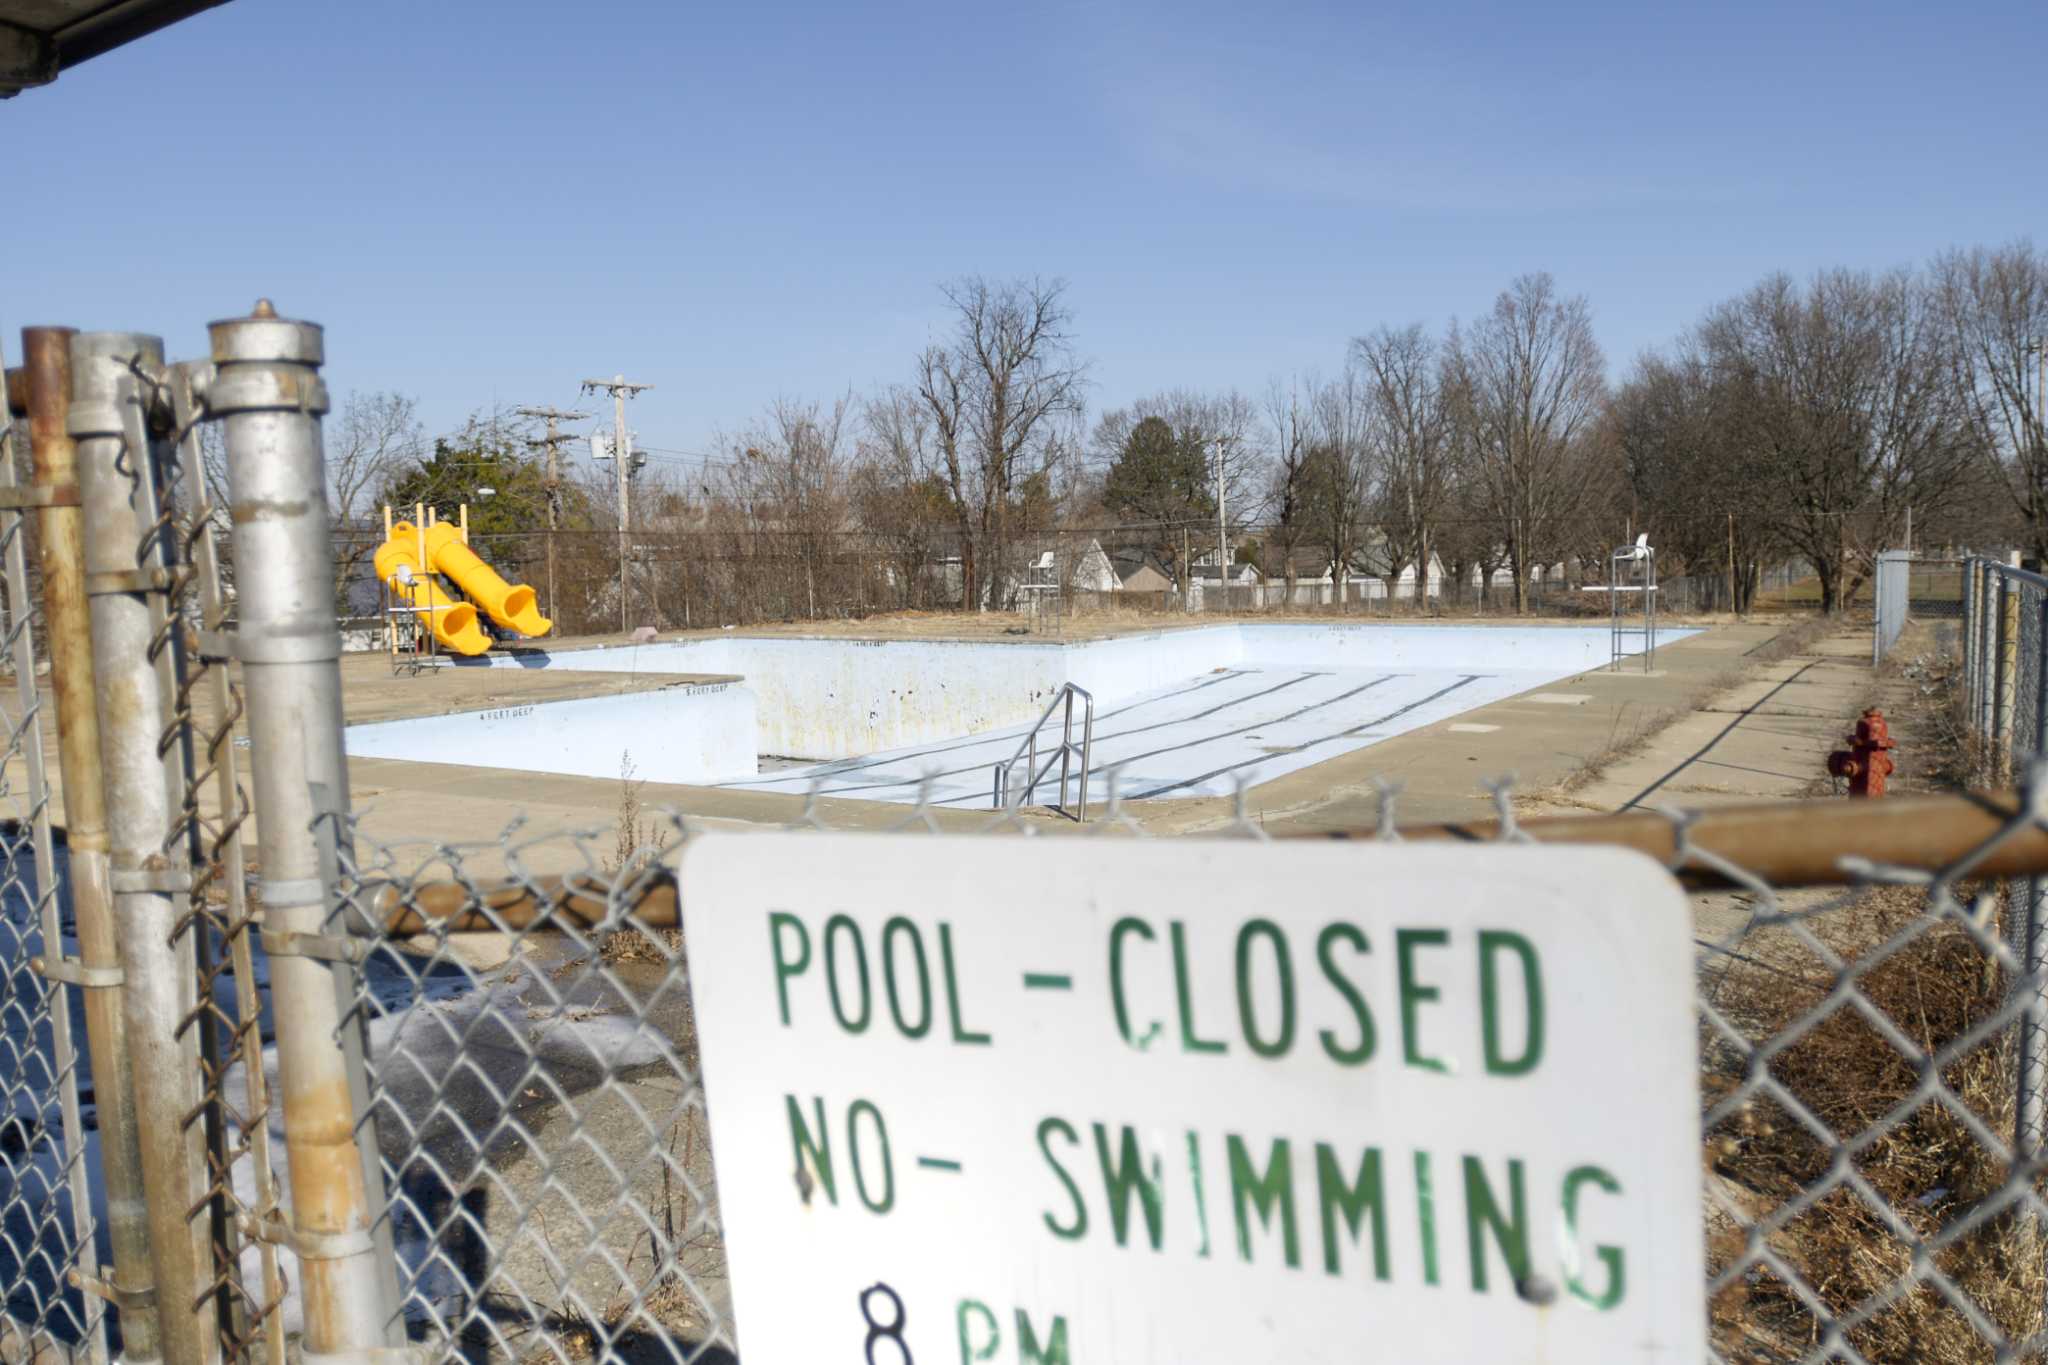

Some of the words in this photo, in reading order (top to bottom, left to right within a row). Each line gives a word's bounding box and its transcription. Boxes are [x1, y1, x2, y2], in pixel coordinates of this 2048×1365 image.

[486, 709, 510, 721] FEET
[512, 706, 534, 718] DEEP
[769, 911, 992, 1045] POOL
[1035, 1115, 1627, 1312] SWIMMING
[858, 1281, 914, 1365] 8
[956, 1298, 1071, 1365] PM
